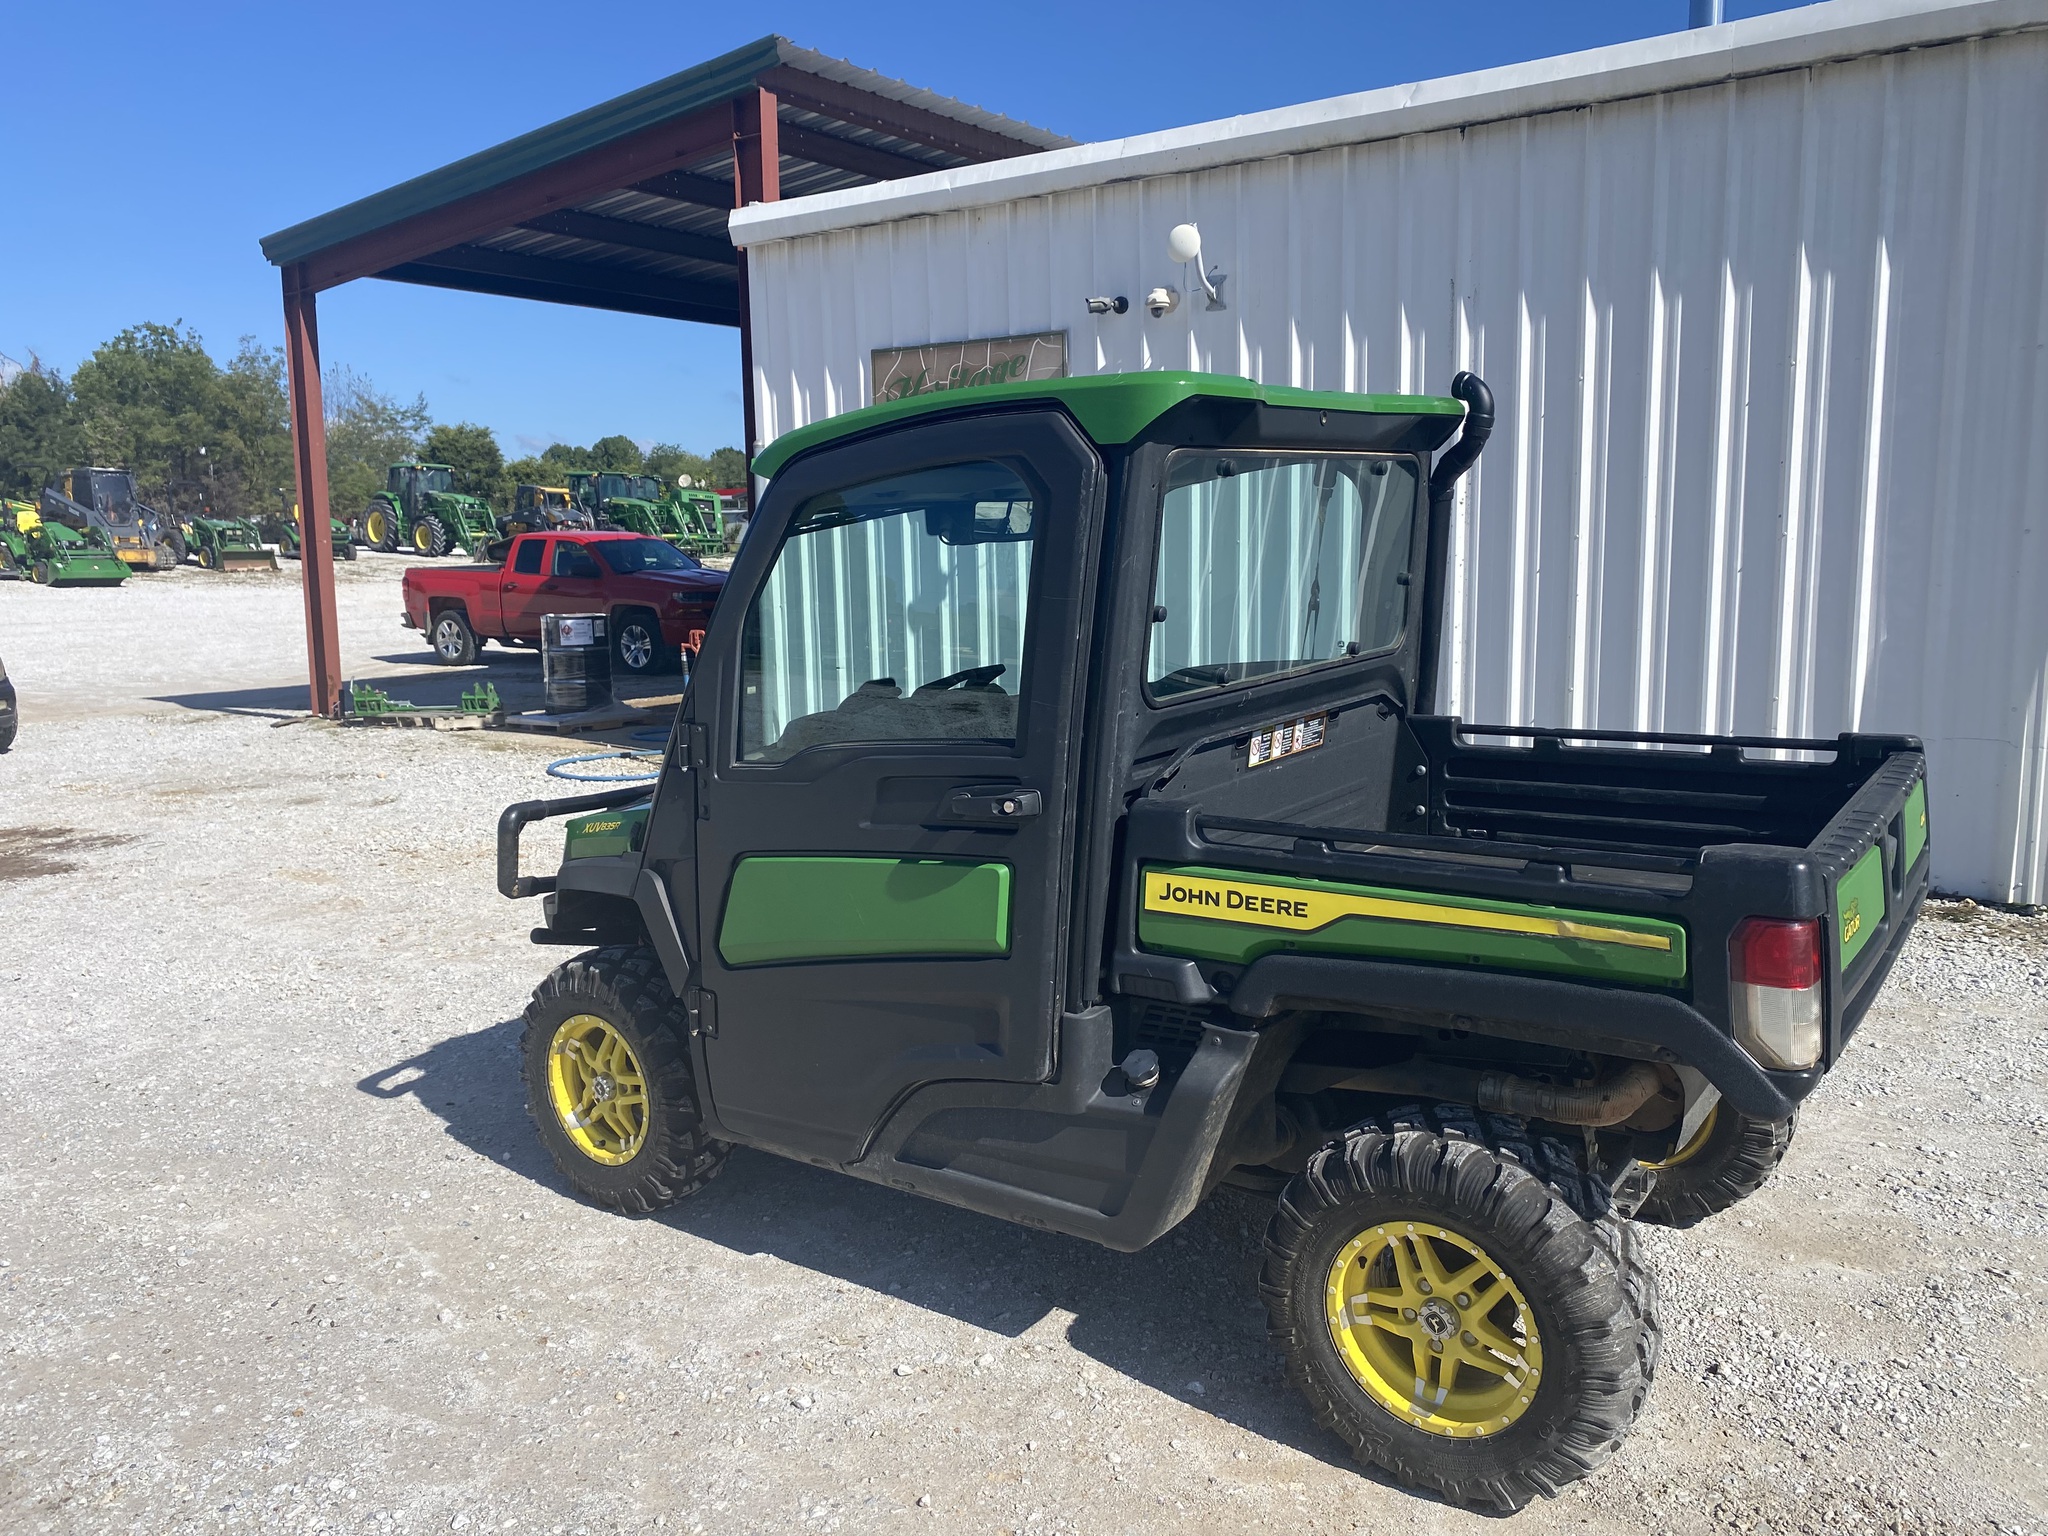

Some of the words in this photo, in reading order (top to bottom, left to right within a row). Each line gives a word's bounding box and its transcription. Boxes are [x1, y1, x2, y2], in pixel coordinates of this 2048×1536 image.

[1159, 882, 1221, 907] JOHN
[1226, 889, 1309, 919] DEERE
[1844, 914, 1860, 943] GATOR
